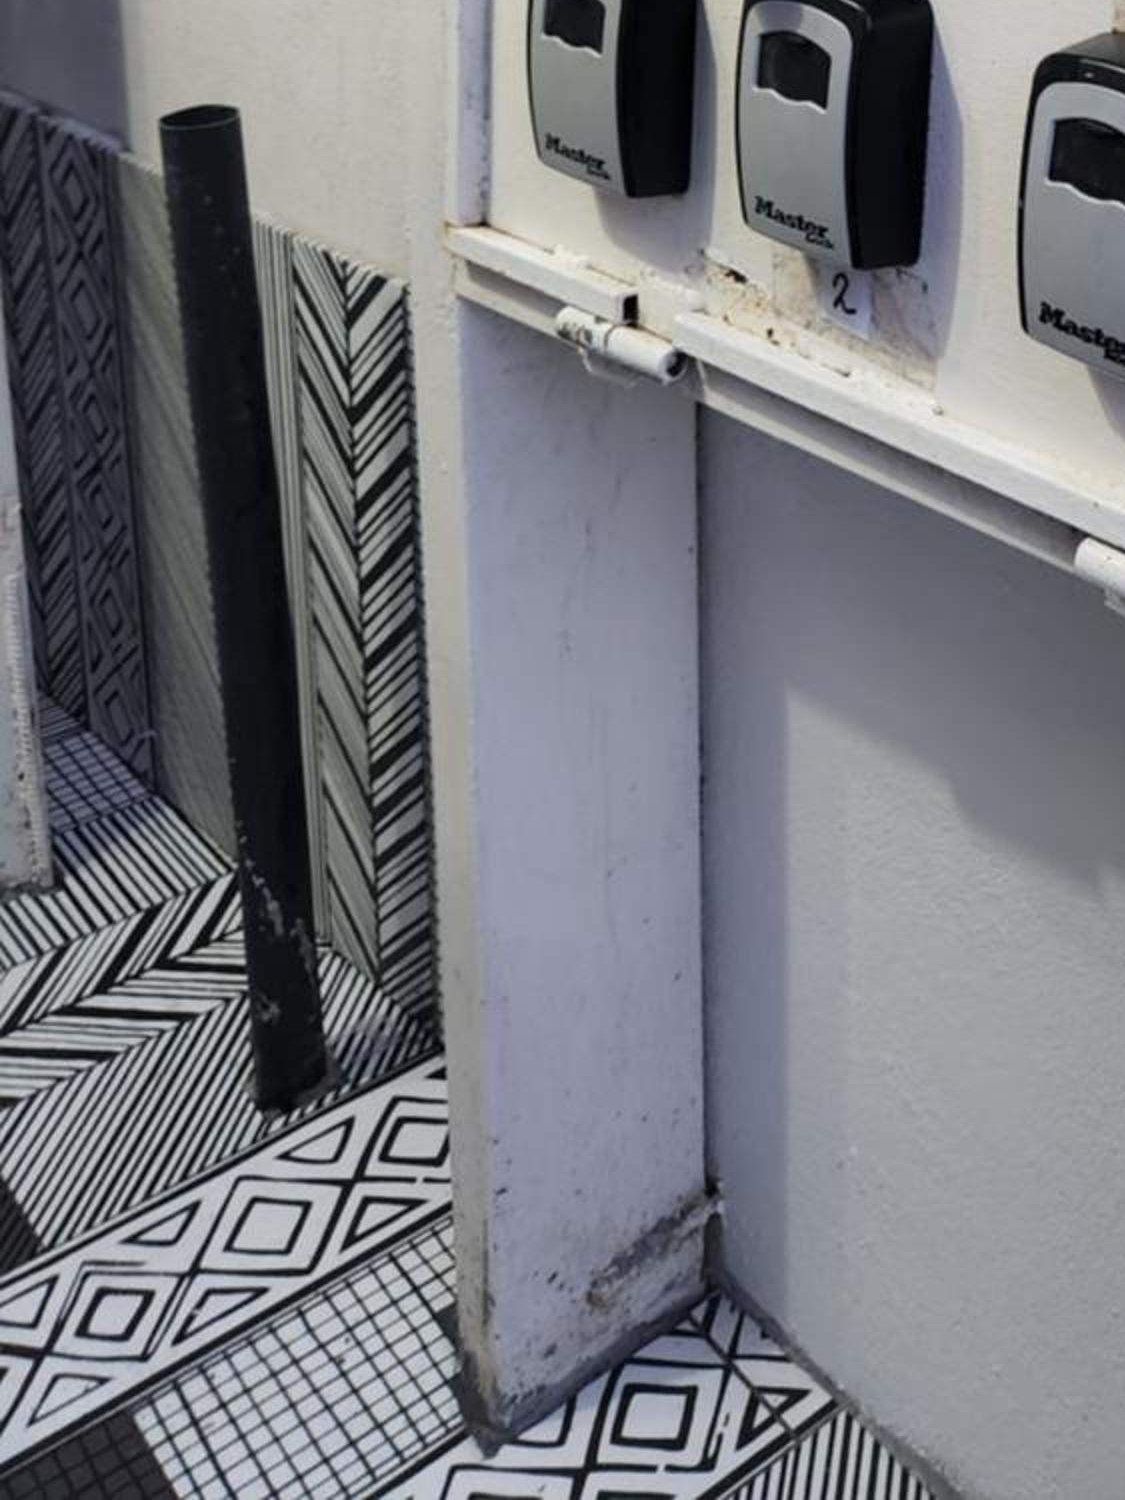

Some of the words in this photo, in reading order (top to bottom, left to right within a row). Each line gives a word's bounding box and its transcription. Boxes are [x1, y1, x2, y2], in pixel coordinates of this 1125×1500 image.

[545, 132, 605, 171] Master
[755, 195, 829, 238] Master
[832, 272, 857, 315] 2
